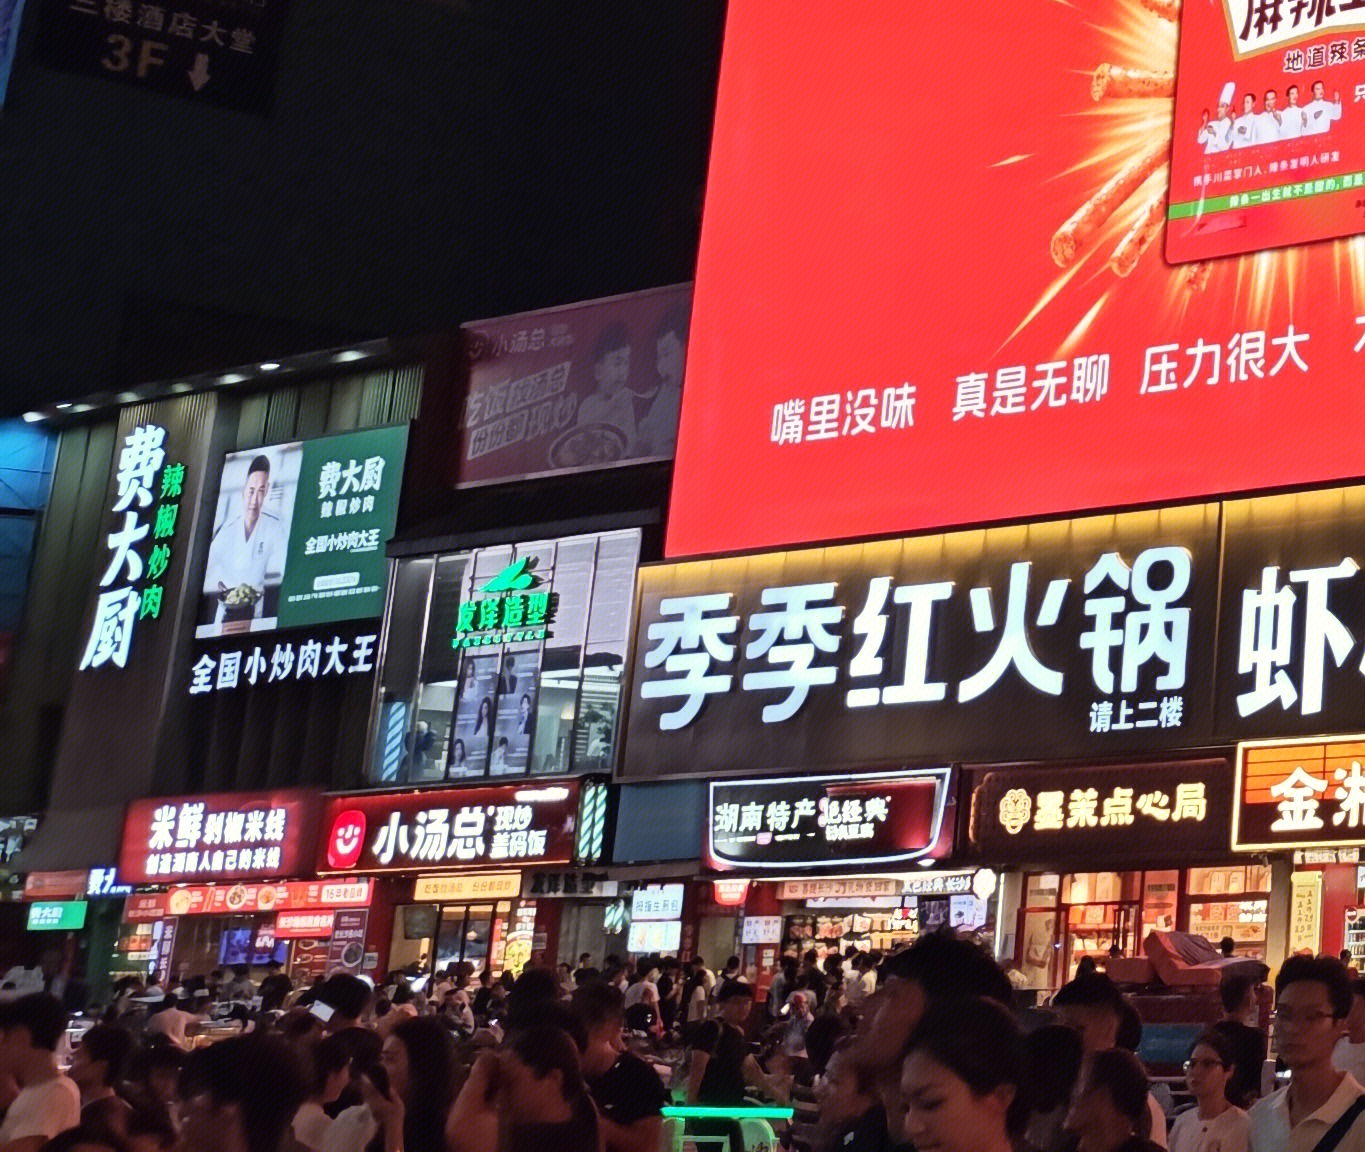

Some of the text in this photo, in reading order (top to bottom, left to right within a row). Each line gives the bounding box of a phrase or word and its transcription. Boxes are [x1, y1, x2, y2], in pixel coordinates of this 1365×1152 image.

[101, 33, 170, 79] 3F
[770, 387, 918, 447] 嘴里没味
[951, 353, 1110, 421] 真是无聊
[1139, 329, 1311, 396] 压力很大
[317, 455, 386, 500] 费大厨
[79, 424, 166, 672] 费大厨
[137, 461, 187, 622] 辣椒炒肉
[304, 528, 381, 556] 全国小炒肉大王
[641, 545, 1195, 732] 季季红火锅
[189, 633, 376, 695] 全国小炒肉大王
[1088, 696, 1184, 734] 请上二楼
[493, 804, 533, 831] 现炒
[714, 798, 816, 833] 湖南特产
[1034, 782, 1207, 831] 墨茉点心局
[372, 806, 486, 865] 小汤总
[490, 829, 548, 859] 盖码饭
